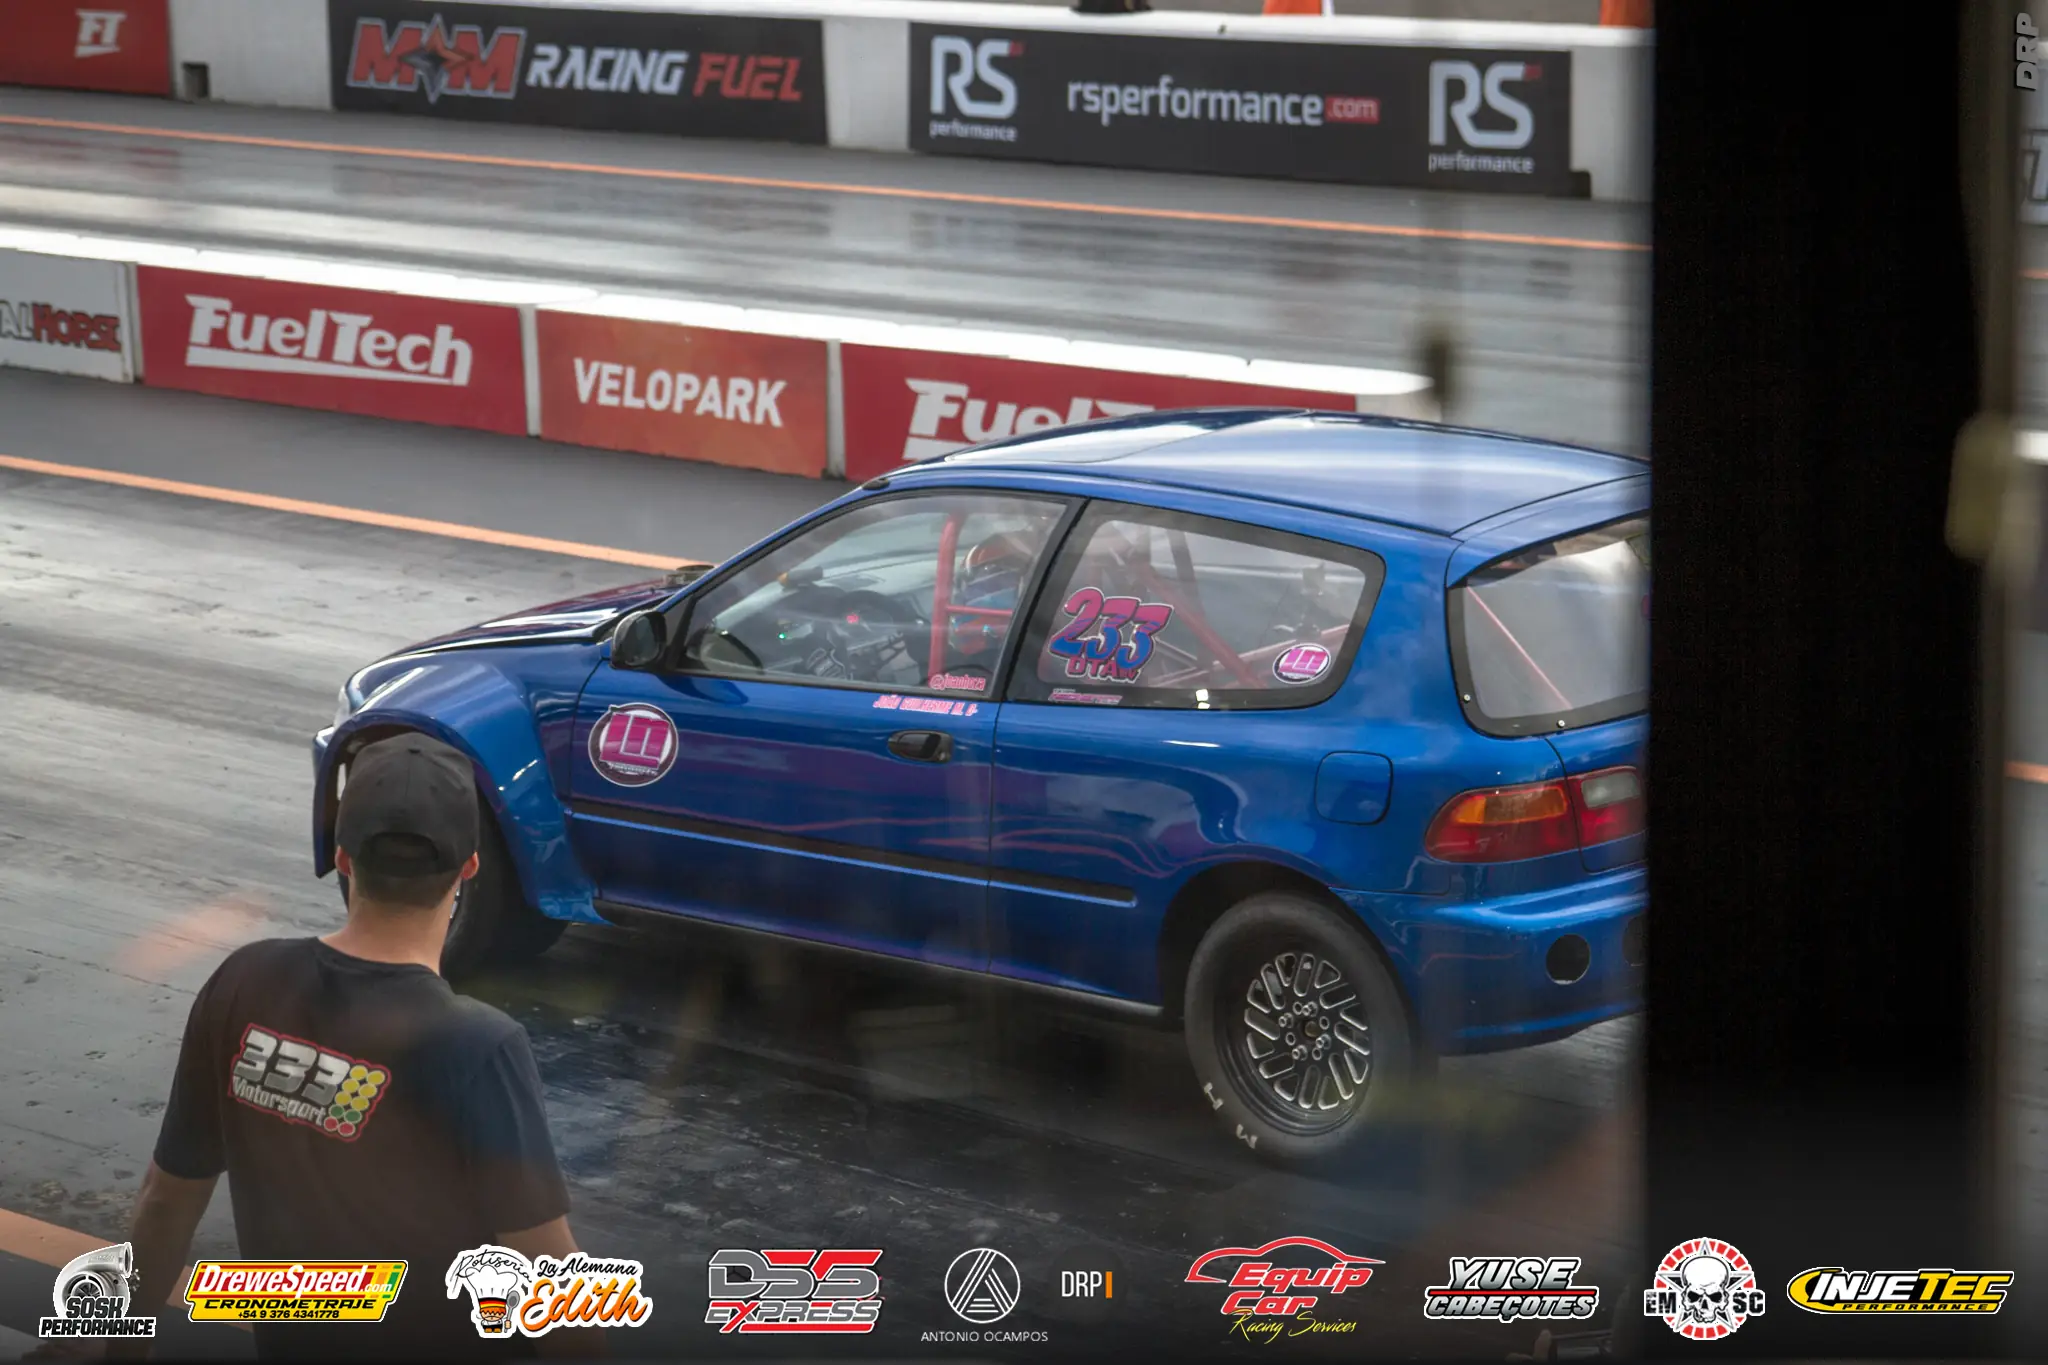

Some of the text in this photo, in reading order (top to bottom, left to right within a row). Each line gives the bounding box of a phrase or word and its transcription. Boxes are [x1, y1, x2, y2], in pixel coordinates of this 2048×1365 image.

[526, 44, 689, 95] RACING
[693, 52, 803, 101] FUEL
[930, 35, 1024, 119] RS
[1429, 60, 1542, 149] RS
[929, 119, 1017, 142] performance
[1428, 151, 1535, 174] performance
[185, 293, 474, 386] FuelTech
[573, 357, 788, 428] VELOPARK
[1048, 586, 1175, 670] 233
[232, 1075, 326, 1127] Motorsport
[233, 1029, 350, 1106] 333
